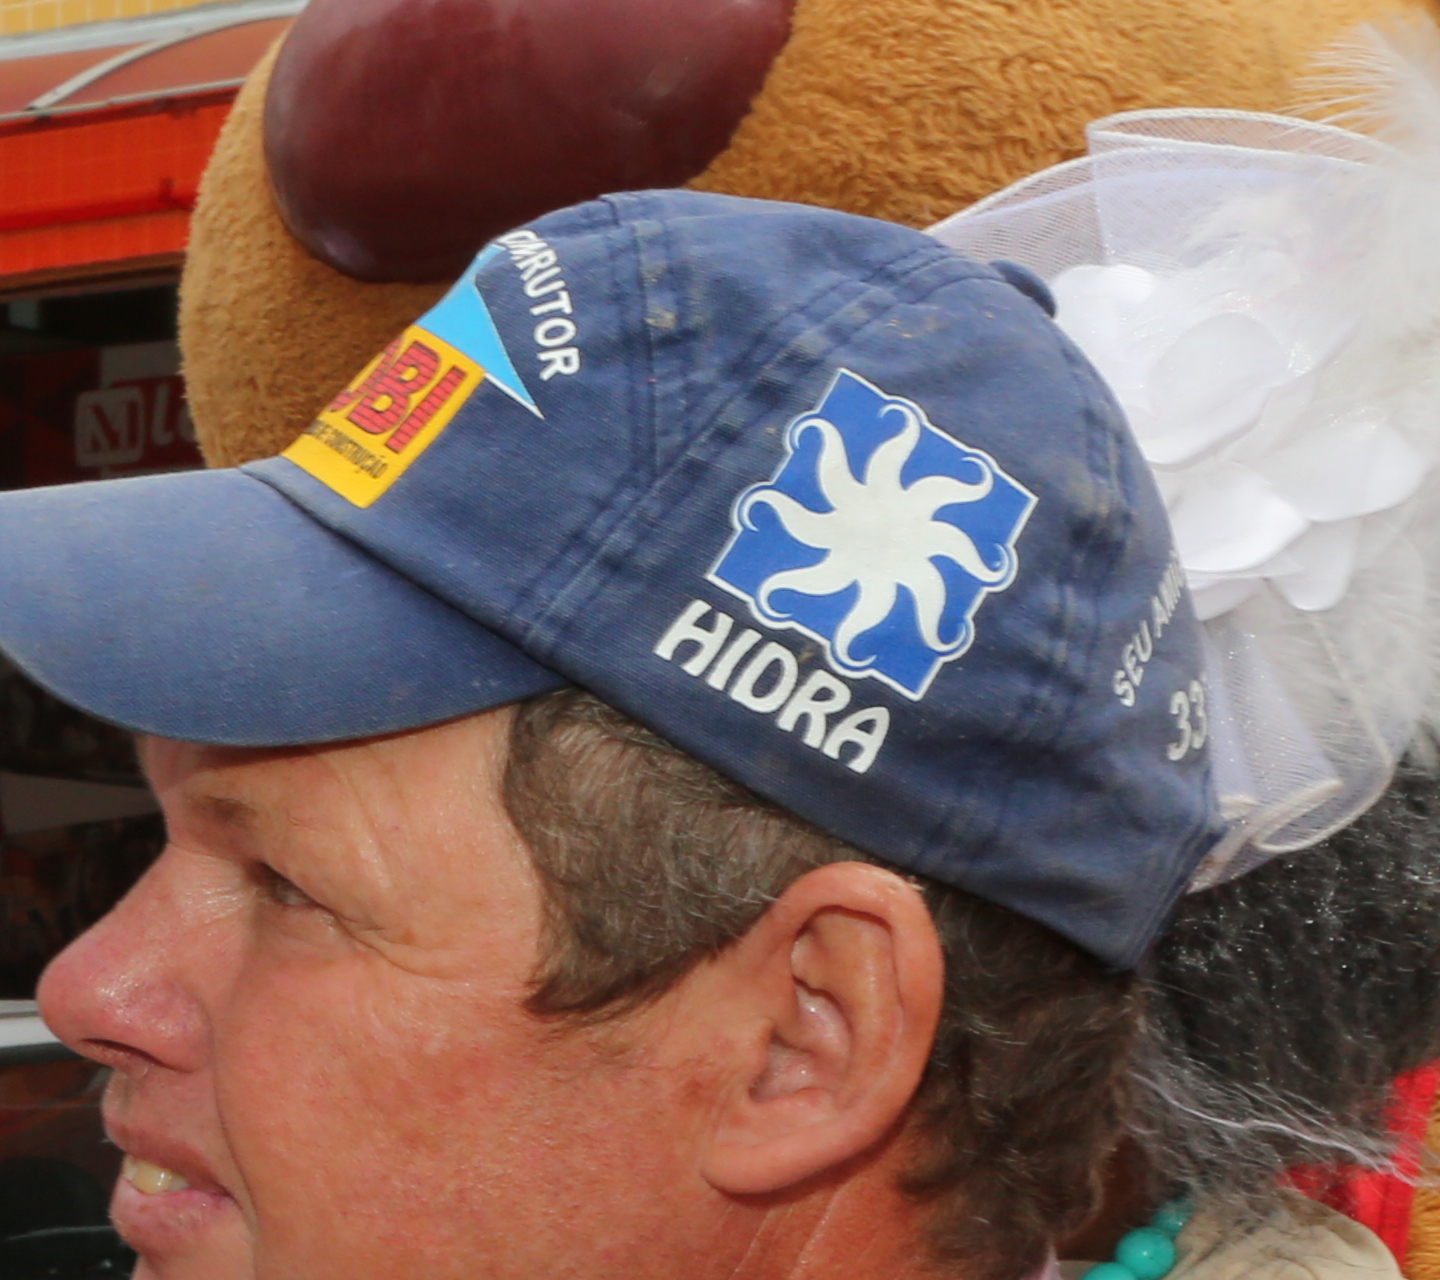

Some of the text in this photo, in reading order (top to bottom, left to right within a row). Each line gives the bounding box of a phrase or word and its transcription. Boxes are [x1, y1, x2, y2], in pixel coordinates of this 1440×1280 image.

[330, 335, 468, 454] BI
[652, 598, 891, 775] HIDRA
[1112, 619, 1153, 707] SEU
